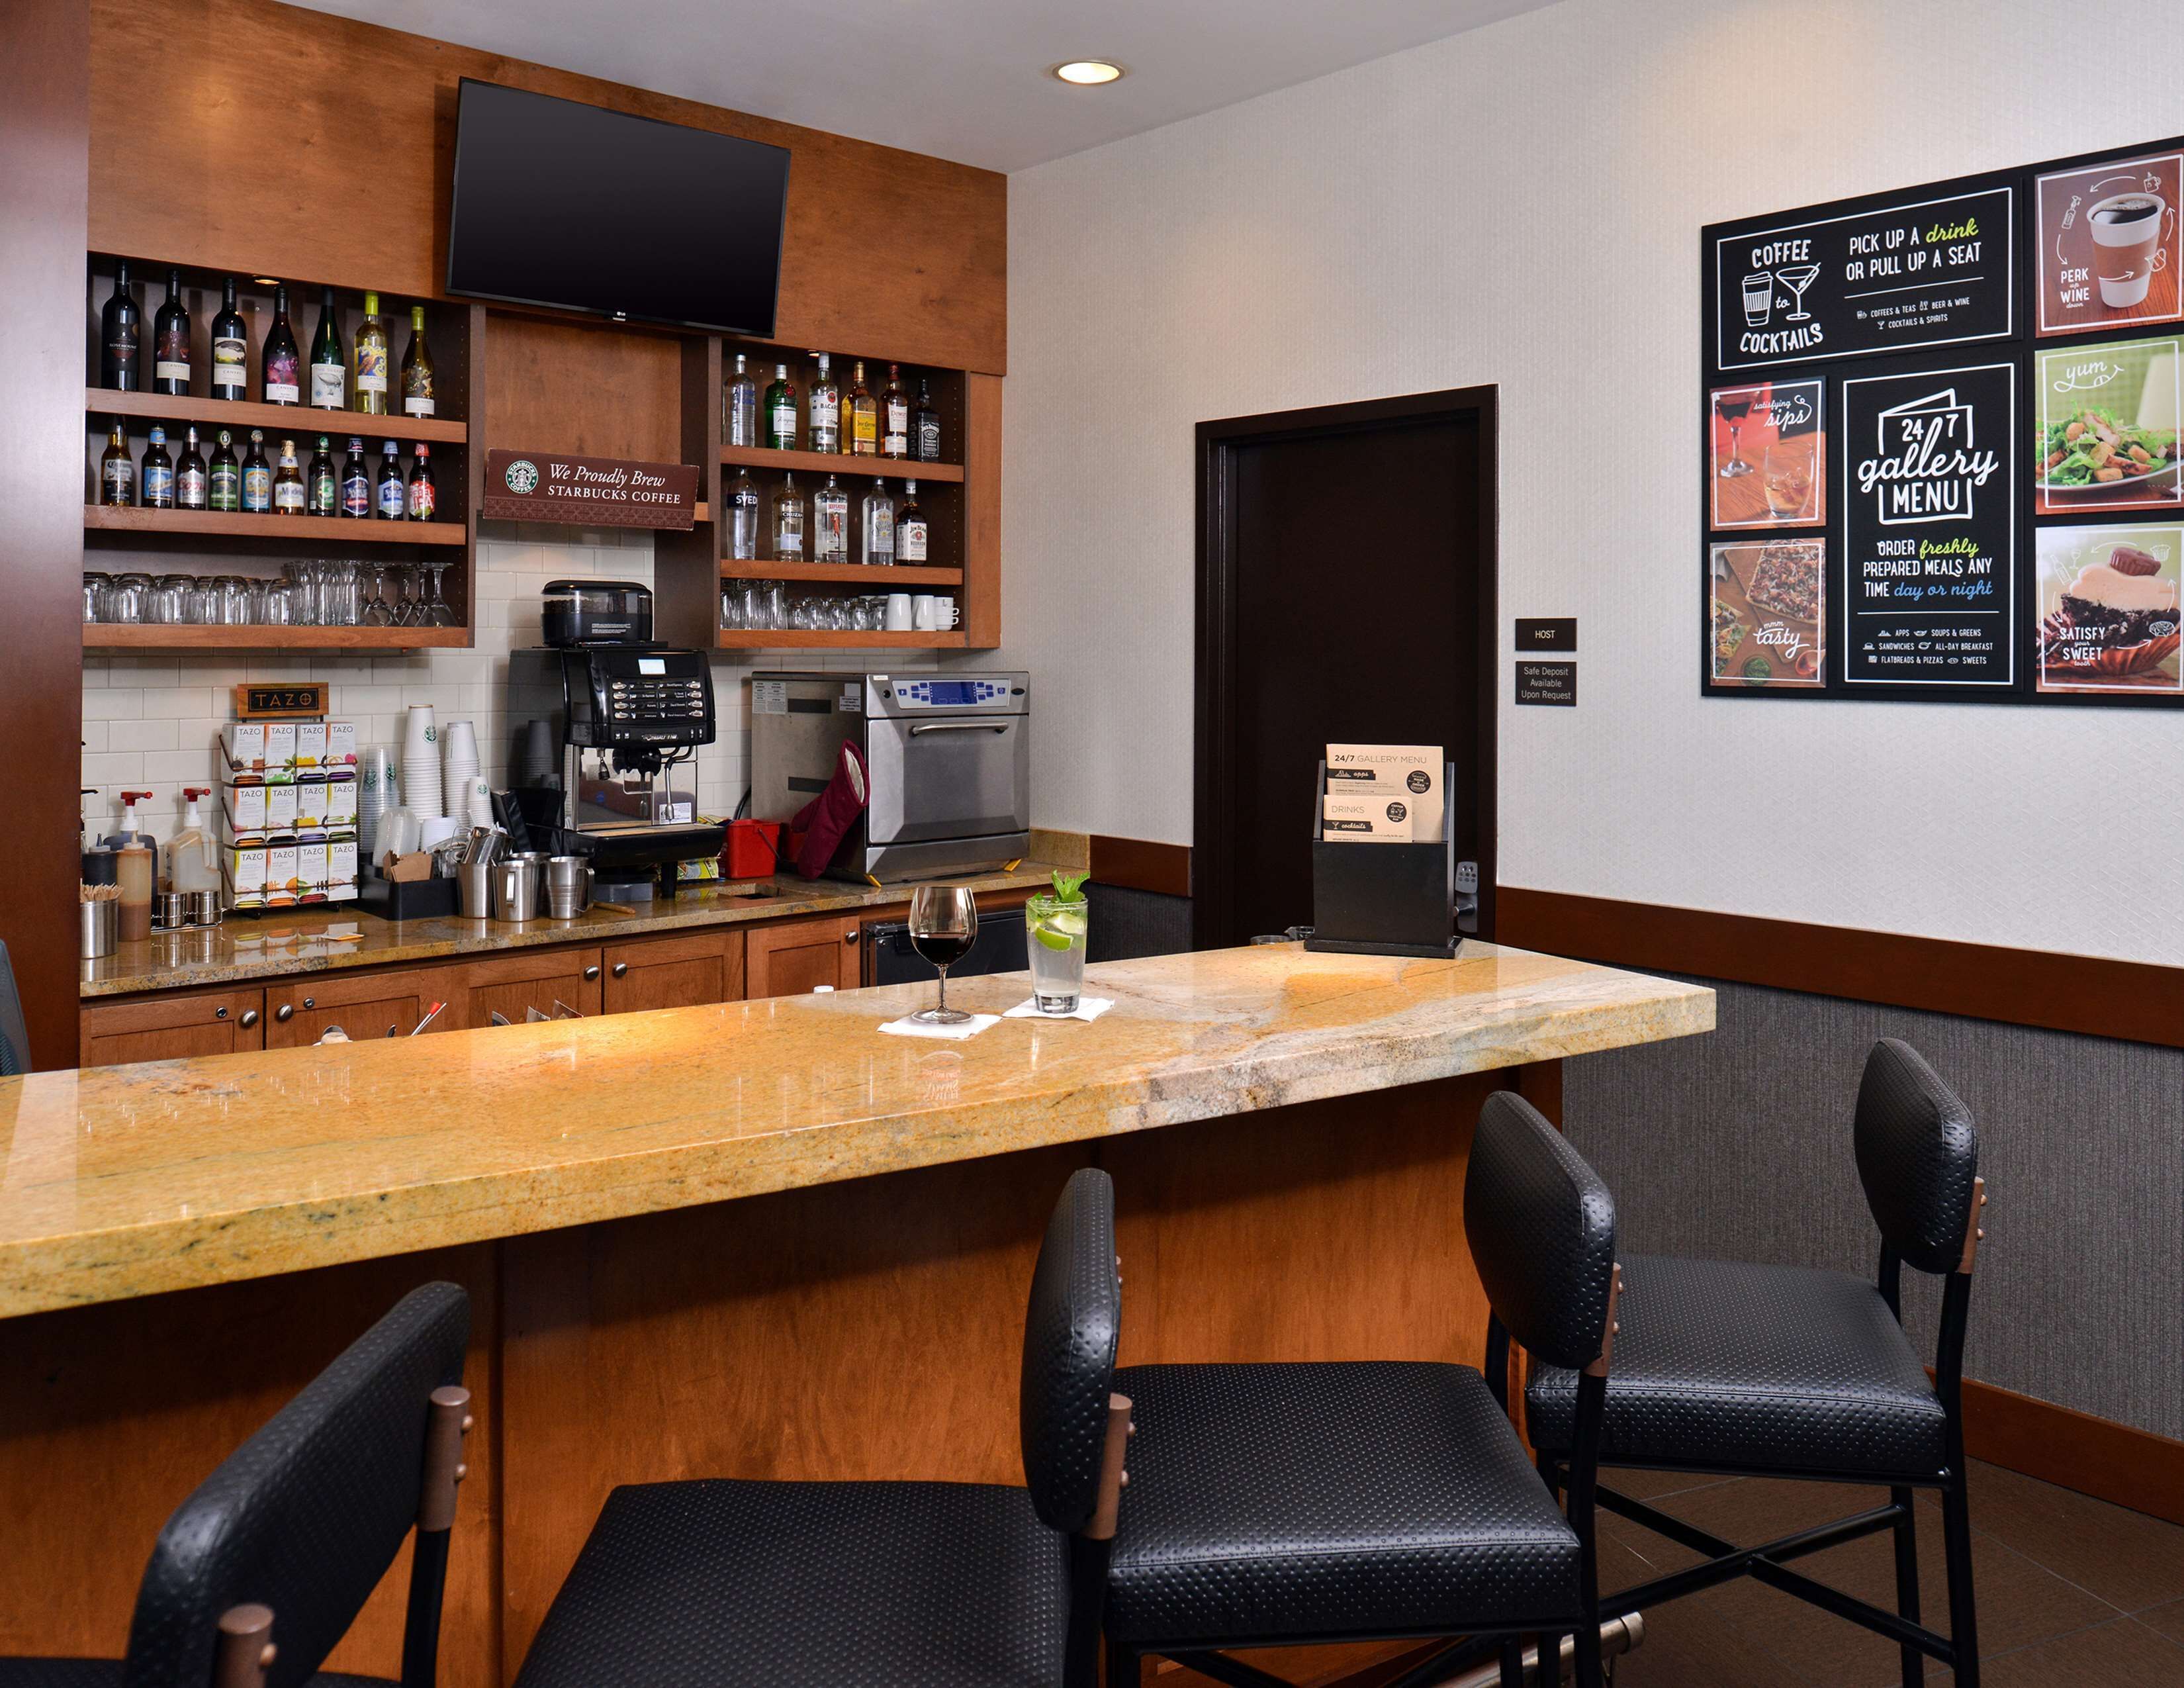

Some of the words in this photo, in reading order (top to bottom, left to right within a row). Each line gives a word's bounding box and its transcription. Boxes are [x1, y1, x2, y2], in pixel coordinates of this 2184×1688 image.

[1849, 233, 1880, 256] PICK
[1886, 228, 1905, 250] UP
[1909, 226, 1920, 246] A
[1925, 217, 1979, 244] drink
[1751, 239, 1812, 269] COFFEE
[1845, 261, 1864, 281] OR
[1869, 255, 1902, 278] PULL
[1907, 250, 1927, 273] UP
[1932, 248, 1942, 268] A
[1948, 242, 1983, 266] SEAT
[2060, 267, 2089, 284] PERK
[1775, 295, 1790, 309] to
[2060, 287, 2090, 304] WINE
[1870, 306, 1893, 318] COFFEES
[1895, 305, 1900, 314] &
[1901, 303, 1917, 313] TEAS
[1931, 300, 1946, 310] BEER
[1947, 299, 1953, 308] &
[1954, 296, 1971, 306] WINE
[1888, 317, 1918, 329] COCKTAILS
[1919, 316, 1925, 326] &
[1926, 313, 1948, 324] SPIRITS
[1739, 322, 1824, 354] COCKTAILS
[1752, 399, 1792, 410] satisfying
[1764, 405, 1812, 432] sips
[1858, 416, 1999, 493] gallery
[508, 462, 537, 477] STARBUCKS
[549, 463, 570, 479] We
[573, 465, 628, 489] Proudly
[630, 470, 666, 487] Brew
[510, 483, 531, 492] COFFEE
[547, 485, 627, 500] STARBUCKS
[631, 491, 681, 504] COFFEE
[735, 494, 758, 506] SVED
[1893, 480, 1959, 514] MENU
[1877, 539, 1915, 556] ORDER
[1919, 538, 1979, 559] freshly
[1863, 560, 1920, 577] PREPARED
[1925, 558, 1964, 577] MEALS
[1968, 557, 1993, 574] ANY
[1864, 581, 1889, 597] TIME
[1893, 582, 1924, 601] day
[1927, 585, 1947, 596] or
[1951, 579, 1993, 600] night
[1535, 630, 1556, 639] HOST
[1958, 628, 1981, 637] GREENS
[2059, 627, 2106, 641] SATISFY
[1752, 627, 1811, 659] tasty
[1878, 642, 1915, 651] SANDWICHES
[1960, 642, 1993, 651] BREAKFAST
[1962, 656, 1987, 665] SWEETS
[2062, 646, 2103, 661] SWEET
[1524, 666, 1540, 675] Safe
[1541, 666, 1569, 677] Deposit
[1529, 679, 1563, 688] Available
[255, 692, 312, 707] TAZO
[1521, 690, 1540, 700] Upon
[1542, 690, 1572, 701] Request
[1334, 754, 1355, 763] 24/7
[1357, 755, 1398, 763] GALLERY
[240, 789, 262, 798] TAZO
[1332, 805, 1365, 814] DRINKS
[241, 853, 263, 861] TAZO
